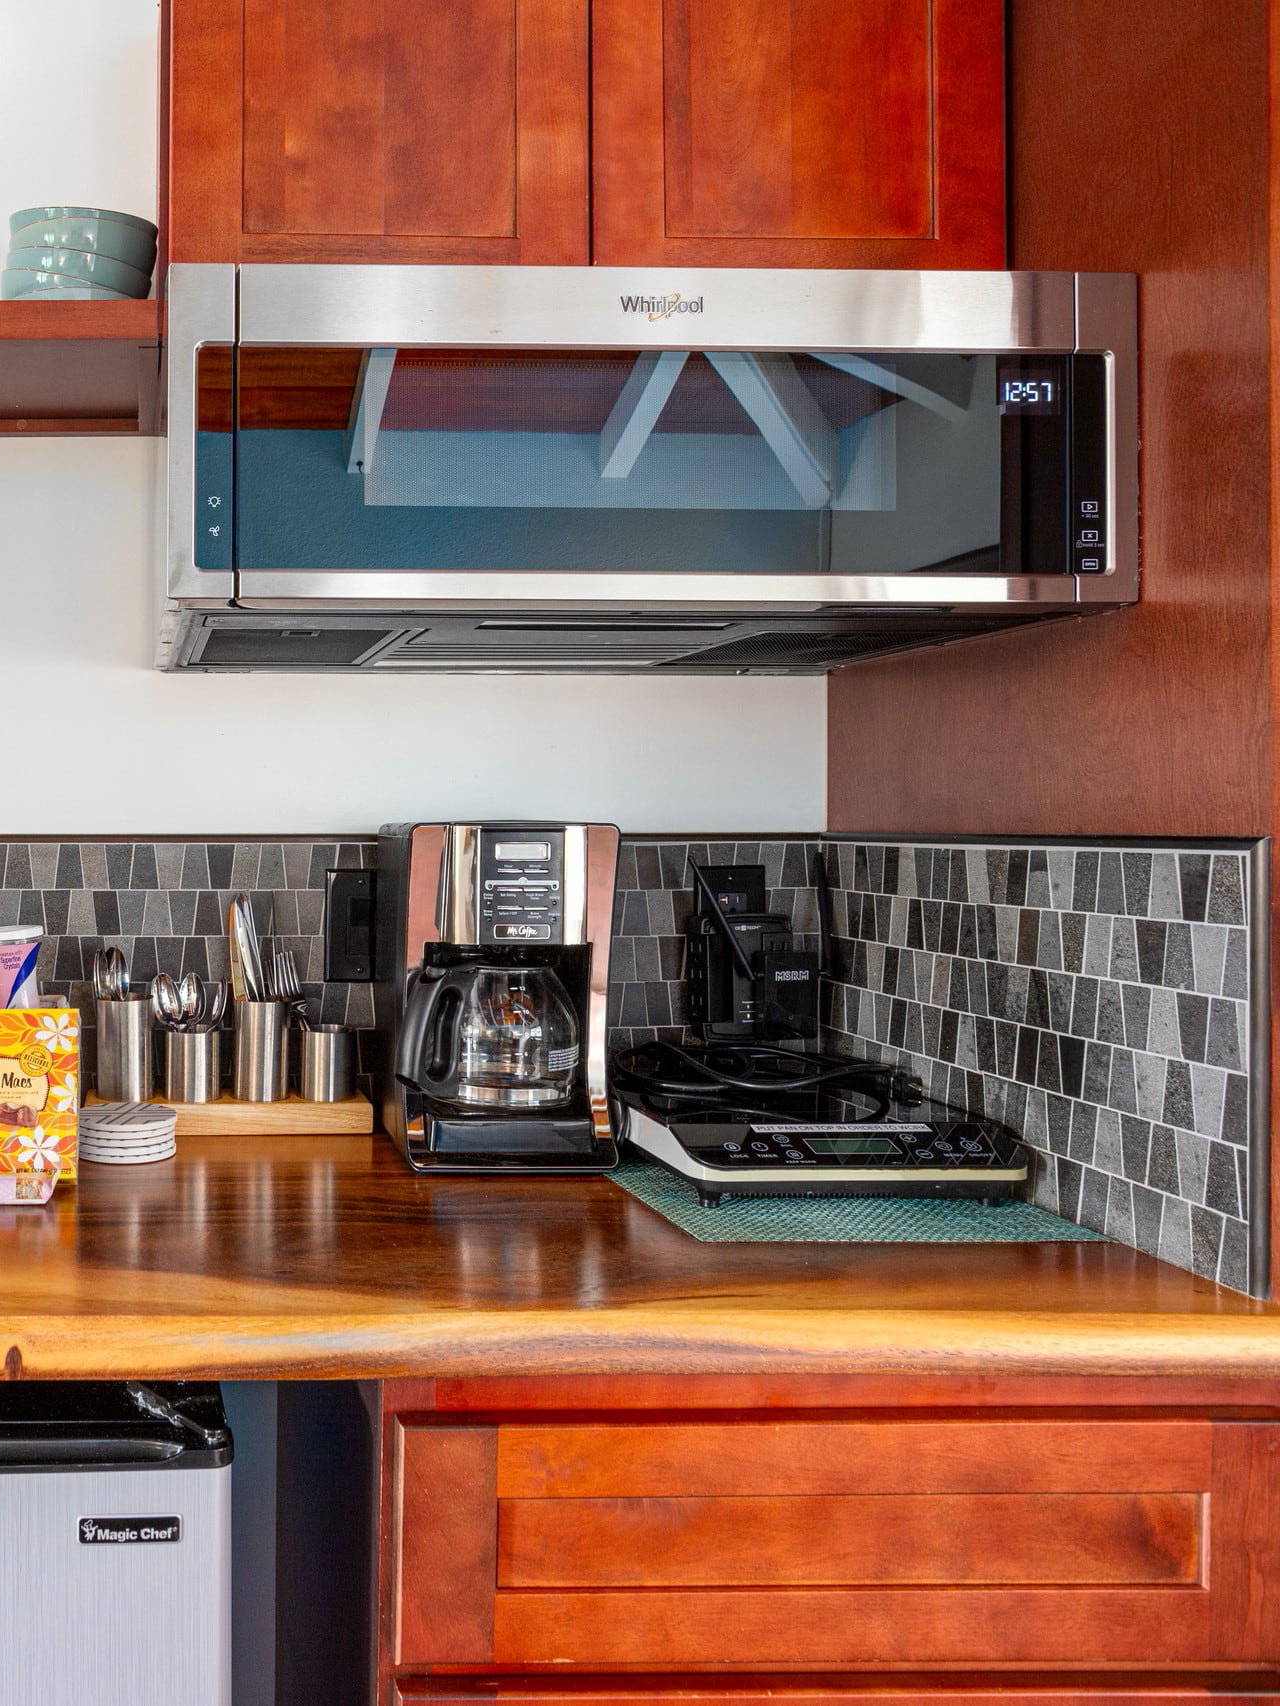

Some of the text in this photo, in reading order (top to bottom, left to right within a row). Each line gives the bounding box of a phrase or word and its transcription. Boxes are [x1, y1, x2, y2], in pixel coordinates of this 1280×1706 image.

[620, 295, 704, 318] Whirlpool
[1003, 381, 1052, 402] 12:57
[518, 926, 538, 938] Coffee
[0, 956, 21, 964] Superfine
[775, 970, 809, 981] MSRM
[1, 1072, 32, 1089] Macs
[97, 1526, 174, 1543] Magic Chef
